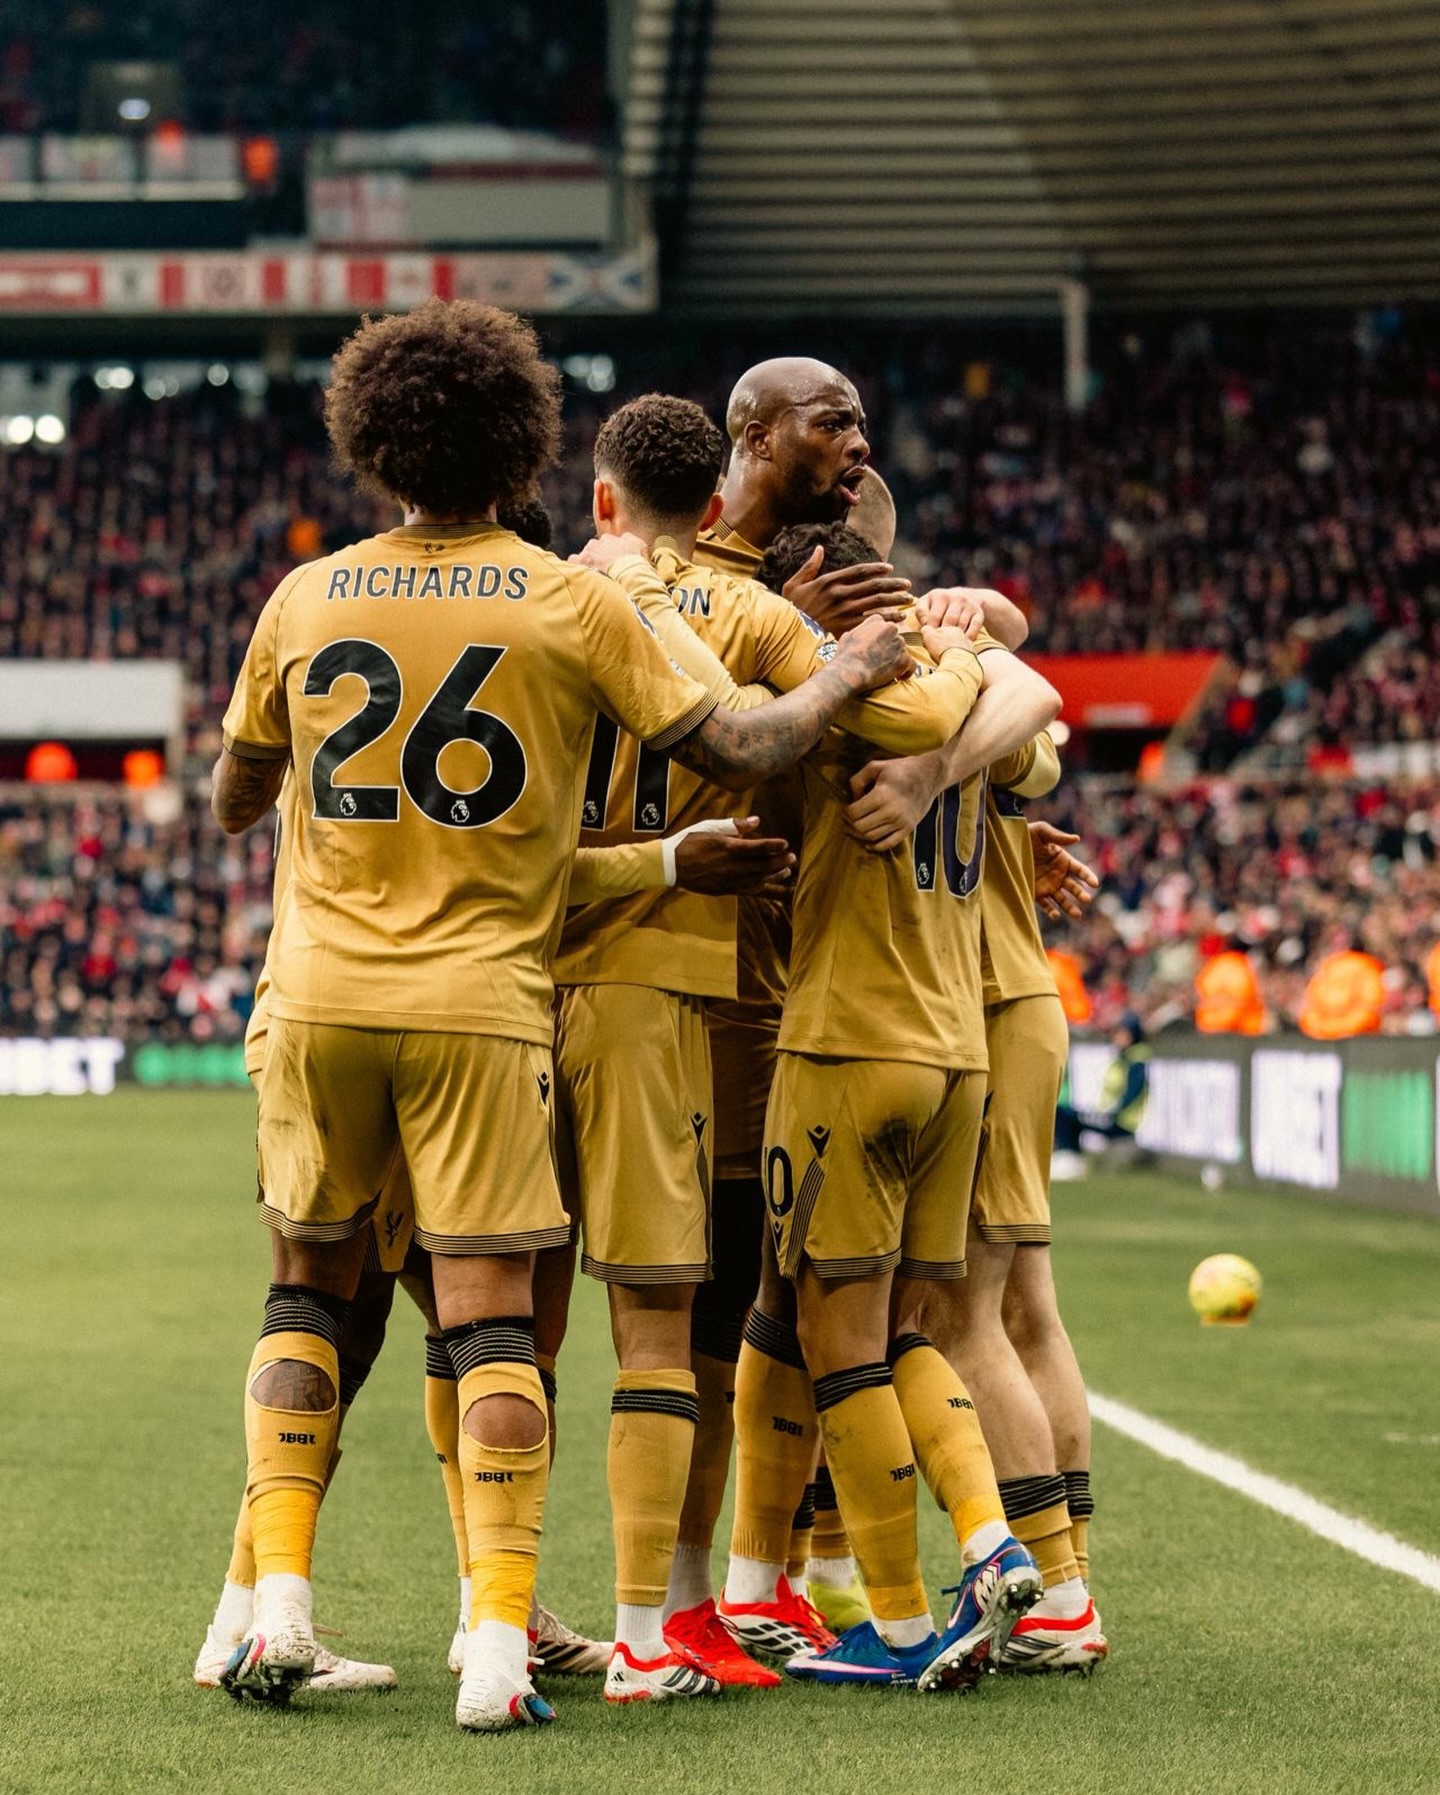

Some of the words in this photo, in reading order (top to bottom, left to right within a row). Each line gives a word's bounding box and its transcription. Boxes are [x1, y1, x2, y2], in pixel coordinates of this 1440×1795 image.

[326, 564, 530, 601] RICHARDS
[303, 638, 528, 829] 26
[912, 764, 990, 898] 10
[764, 1145, 794, 1218] 0
